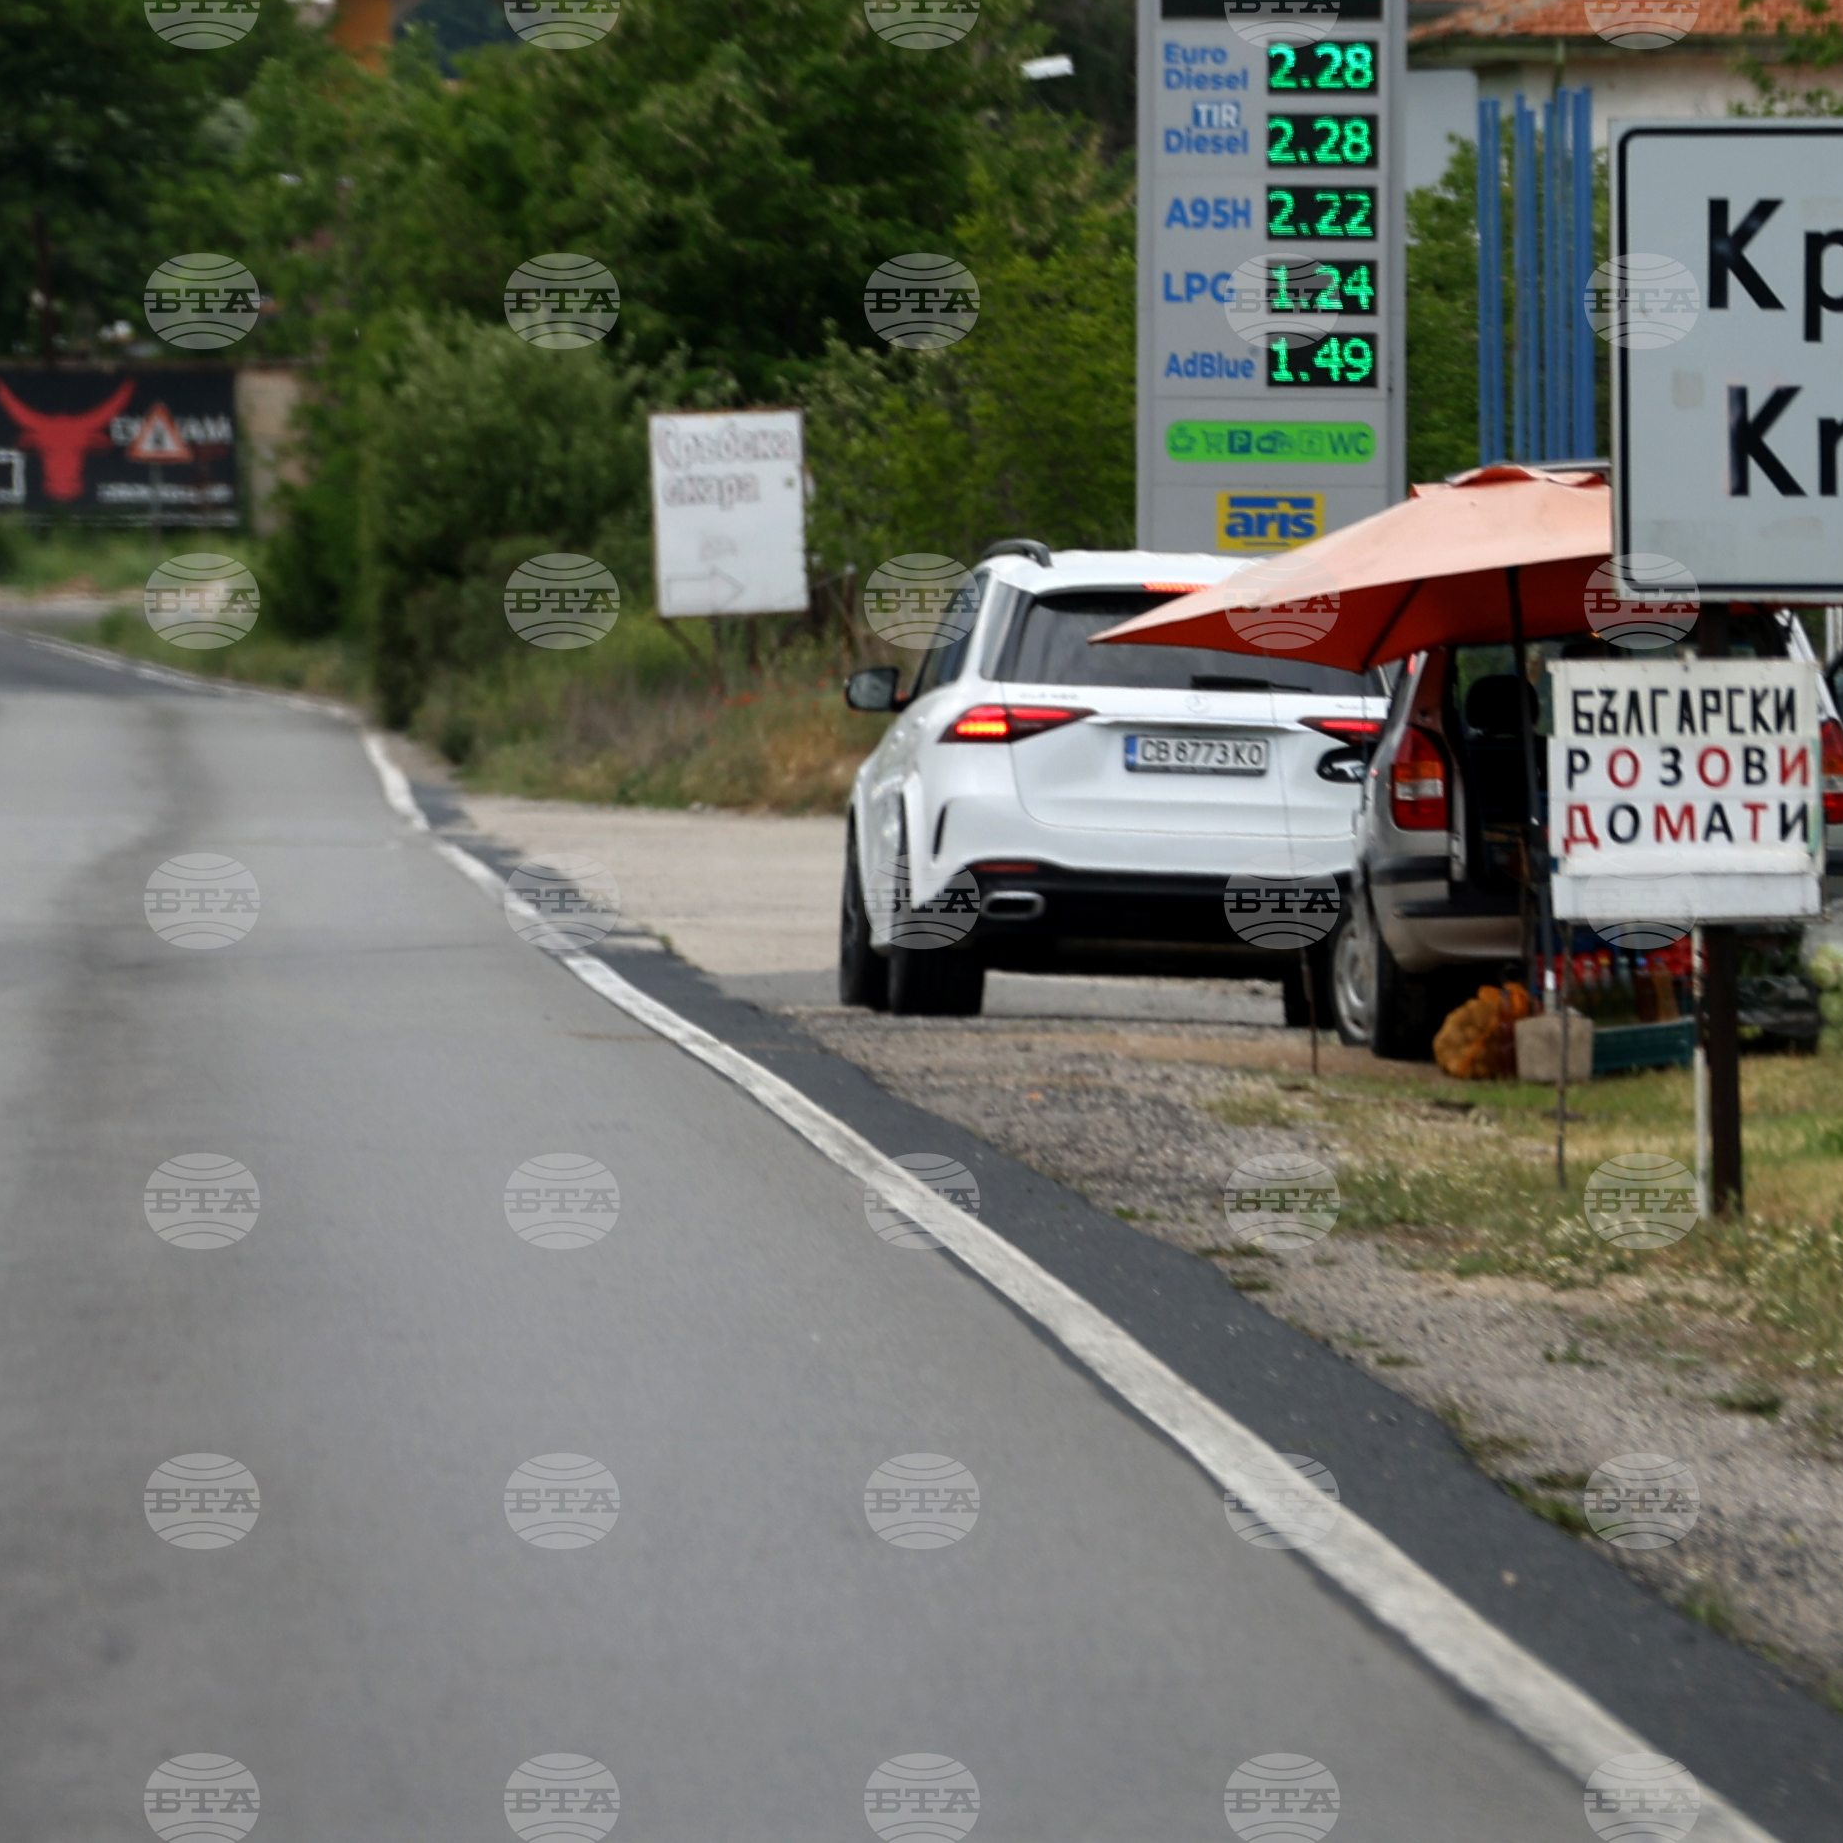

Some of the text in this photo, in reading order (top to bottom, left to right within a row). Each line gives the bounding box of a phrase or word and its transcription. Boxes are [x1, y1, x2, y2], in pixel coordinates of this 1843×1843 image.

[1164, 42, 1228, 65] Euro
[1267, 43, 1374, 89] 2.28
[1164, 69, 1248, 92] Diesel
[1194, 103, 1240, 127] TIR
[1164, 129, 1248, 154] Diesel
[1266, 116, 1372, 165] 2.28
[1165, 197, 1252, 229] A95H
[1268, 189, 1373, 237] 2.22
[1164, 272, 1237, 303] LPG
[1270, 264, 1374, 311] 1.24
[1165, 353, 1255, 379] AdBlue
[1270, 337, 1374, 383] 1.49
[1330, 432, 1371, 455] WC
[1224, 507, 1317, 540] aris
[1572, 687, 1797, 736] БЪЛГАРСКИ
[1567, 746, 1810, 790] РОЗОВИ
[1563, 802, 1810, 855] ДОМАТИ
